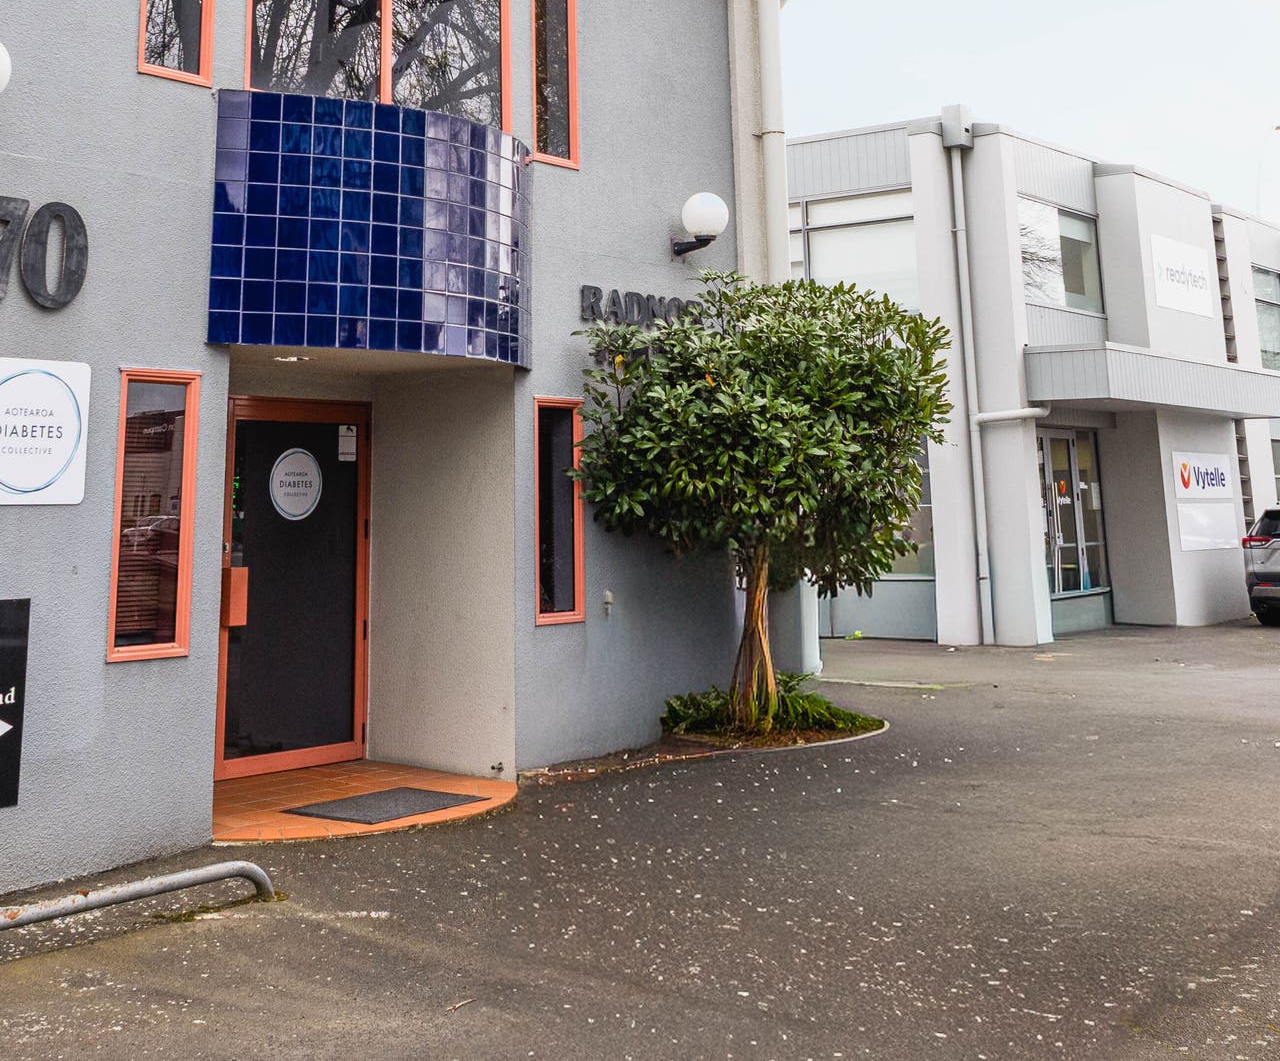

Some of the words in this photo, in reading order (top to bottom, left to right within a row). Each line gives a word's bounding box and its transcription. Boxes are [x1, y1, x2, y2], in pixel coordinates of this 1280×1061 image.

[4, 407, 54, 417] AOTEAROA
[1, 446, 53, 455] COLLECTIVE
[1193, 466, 1226, 490] Vytelle
[279, 480, 313, 488] DIABETES
